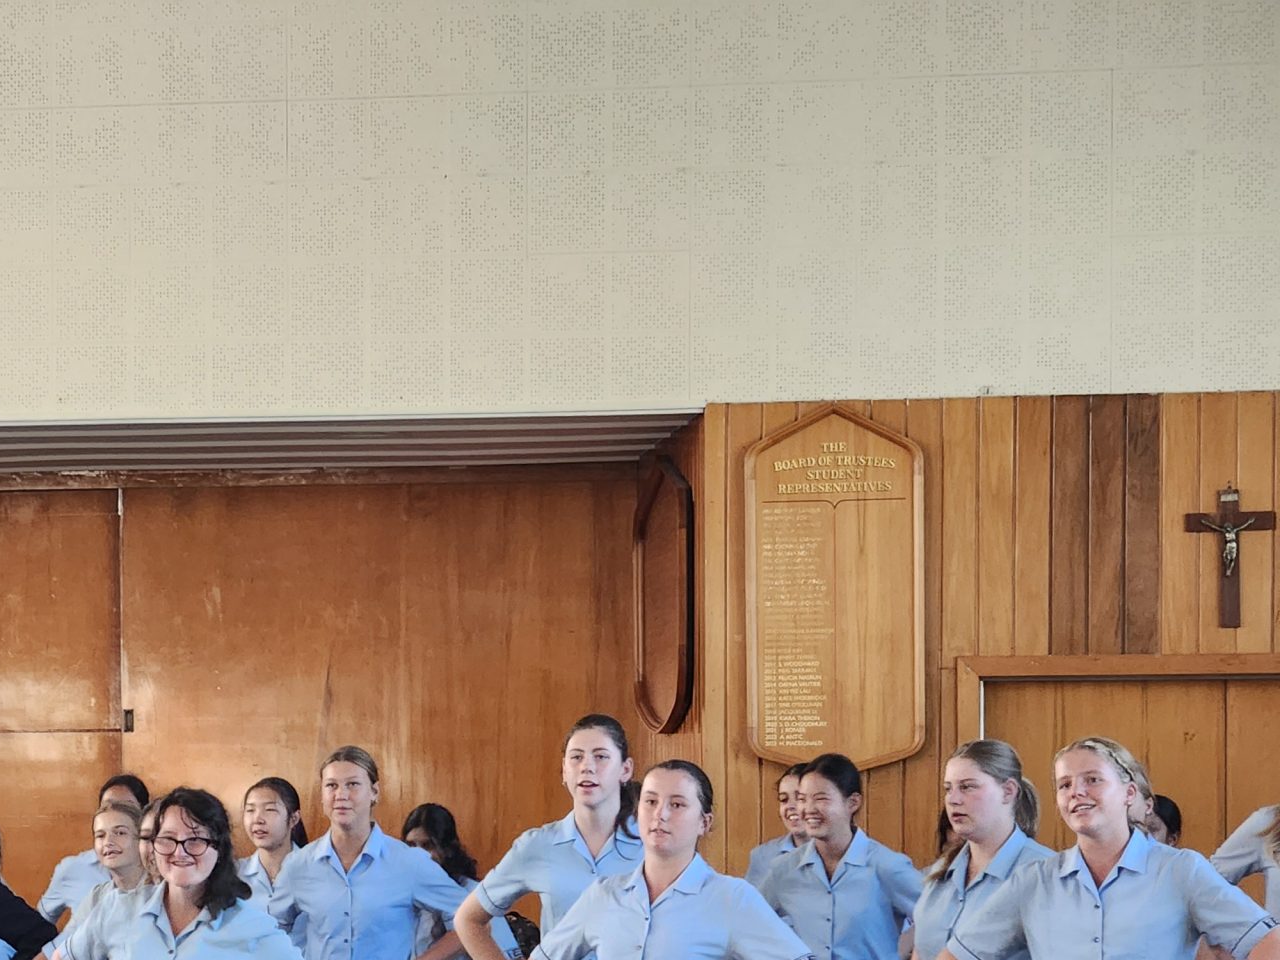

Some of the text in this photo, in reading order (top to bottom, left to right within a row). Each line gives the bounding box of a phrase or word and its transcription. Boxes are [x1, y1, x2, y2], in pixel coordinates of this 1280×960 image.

[821, 442, 847, 453] THE
[773, 455, 896, 471] BOARD OF TRUSTEES
[806, 469, 863, 480] STUDENT
[777, 481, 892, 494] REPRESENTATIVES
